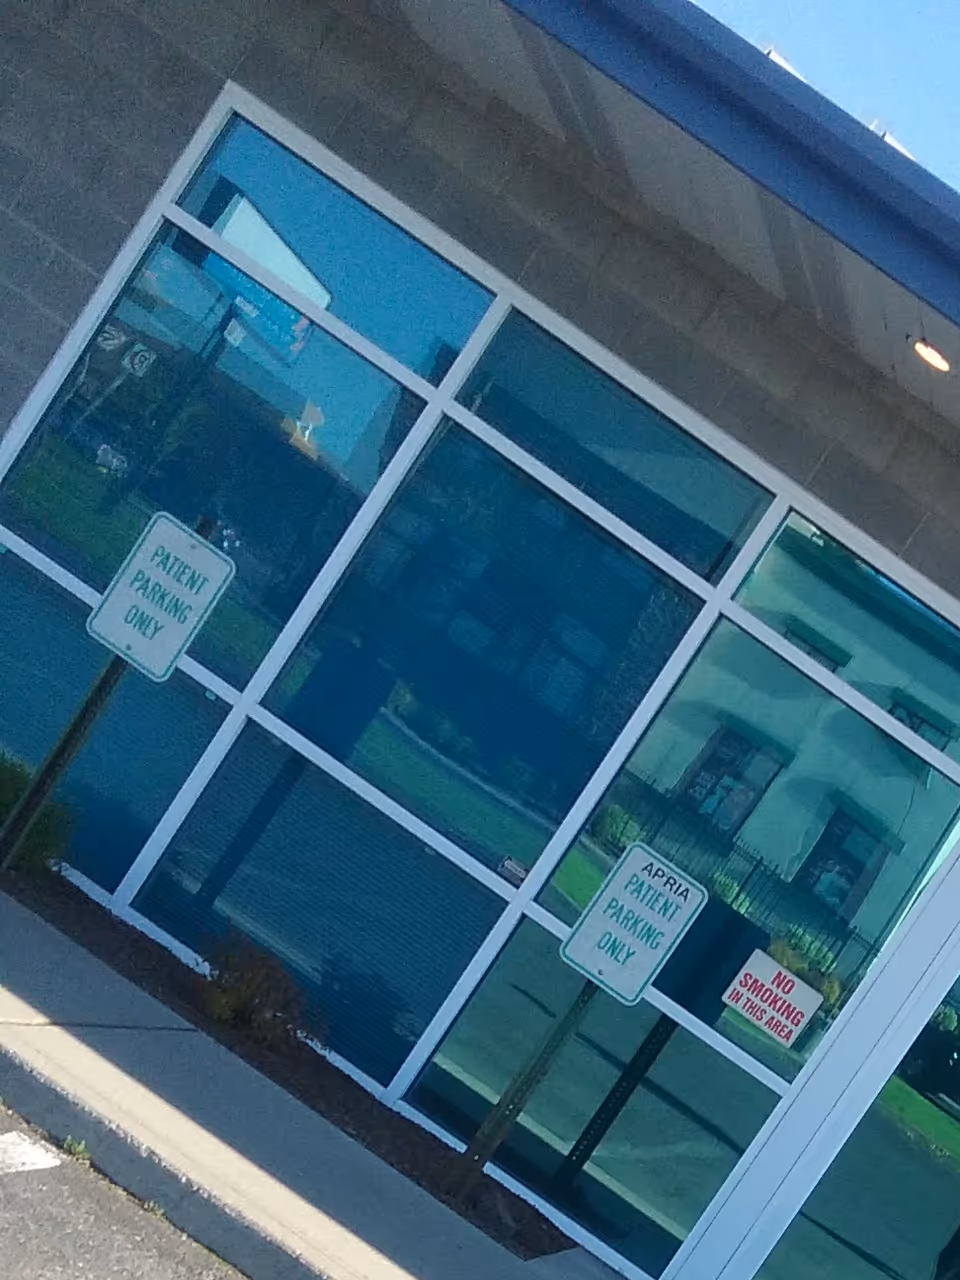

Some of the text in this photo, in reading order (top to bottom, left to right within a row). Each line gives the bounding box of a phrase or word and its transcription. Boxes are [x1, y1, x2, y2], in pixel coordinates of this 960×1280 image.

[149, 544, 209, 596] PATIENT
[124, 604, 165, 641] ONLY
[129, 569, 193, 625] PARKING
[624, 872, 682, 922] PATIENT
[641, 861, 692, 903] APRIA
[596, 931, 637, 966] ONLY
[603, 897, 665, 950] PARKING
[738, 972, 805, 1028] SMOKING
[771, 970, 796, 995] NO
[727, 987, 795, 1043] IN THIS AREA
